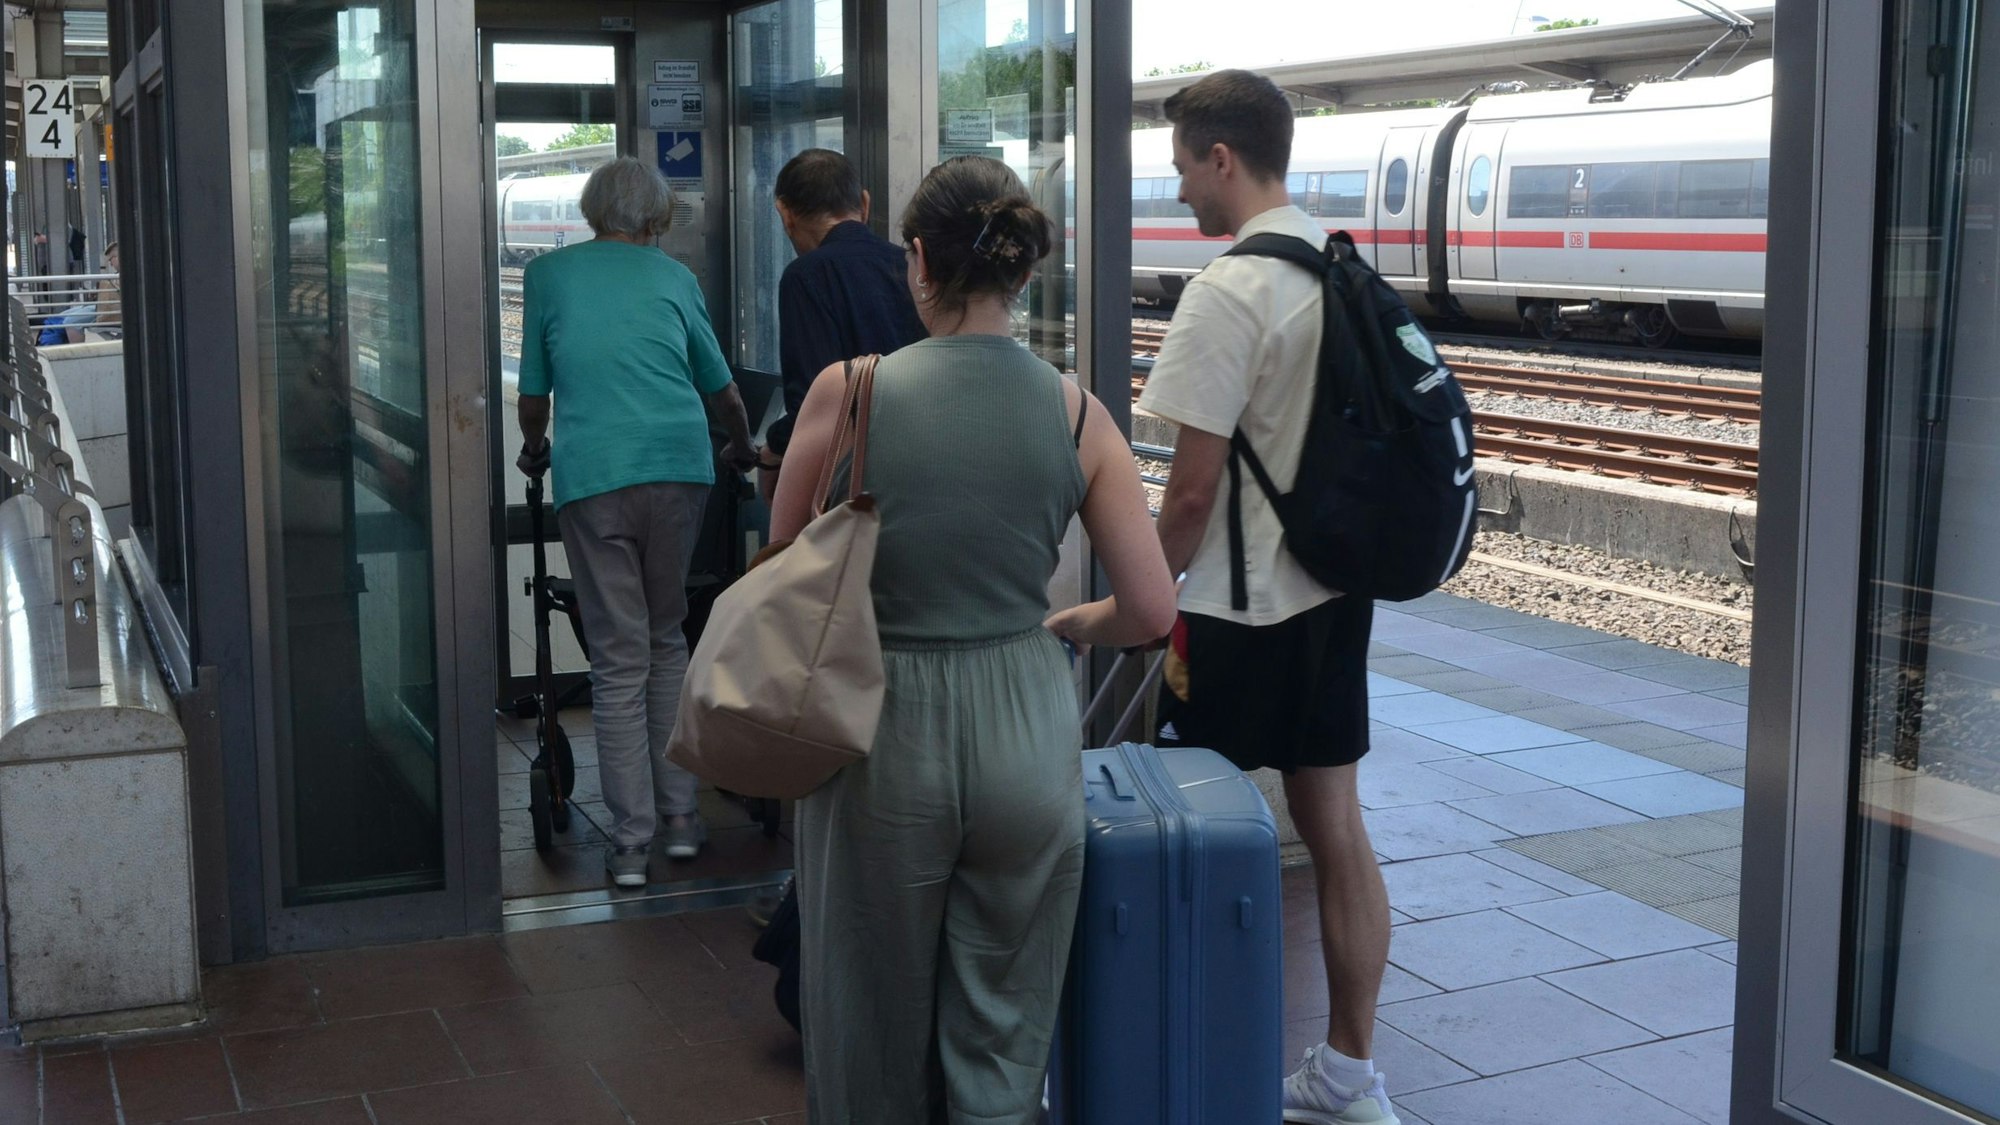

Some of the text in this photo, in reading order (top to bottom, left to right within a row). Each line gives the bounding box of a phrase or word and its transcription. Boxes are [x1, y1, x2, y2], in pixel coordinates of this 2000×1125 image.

[27, 84, 72, 115] 24
[40, 119, 61, 150] 4
[1310, 176, 1318, 192] 2
[1574, 168, 1584, 188] 2
[1570, 234, 1583, 246] DB
